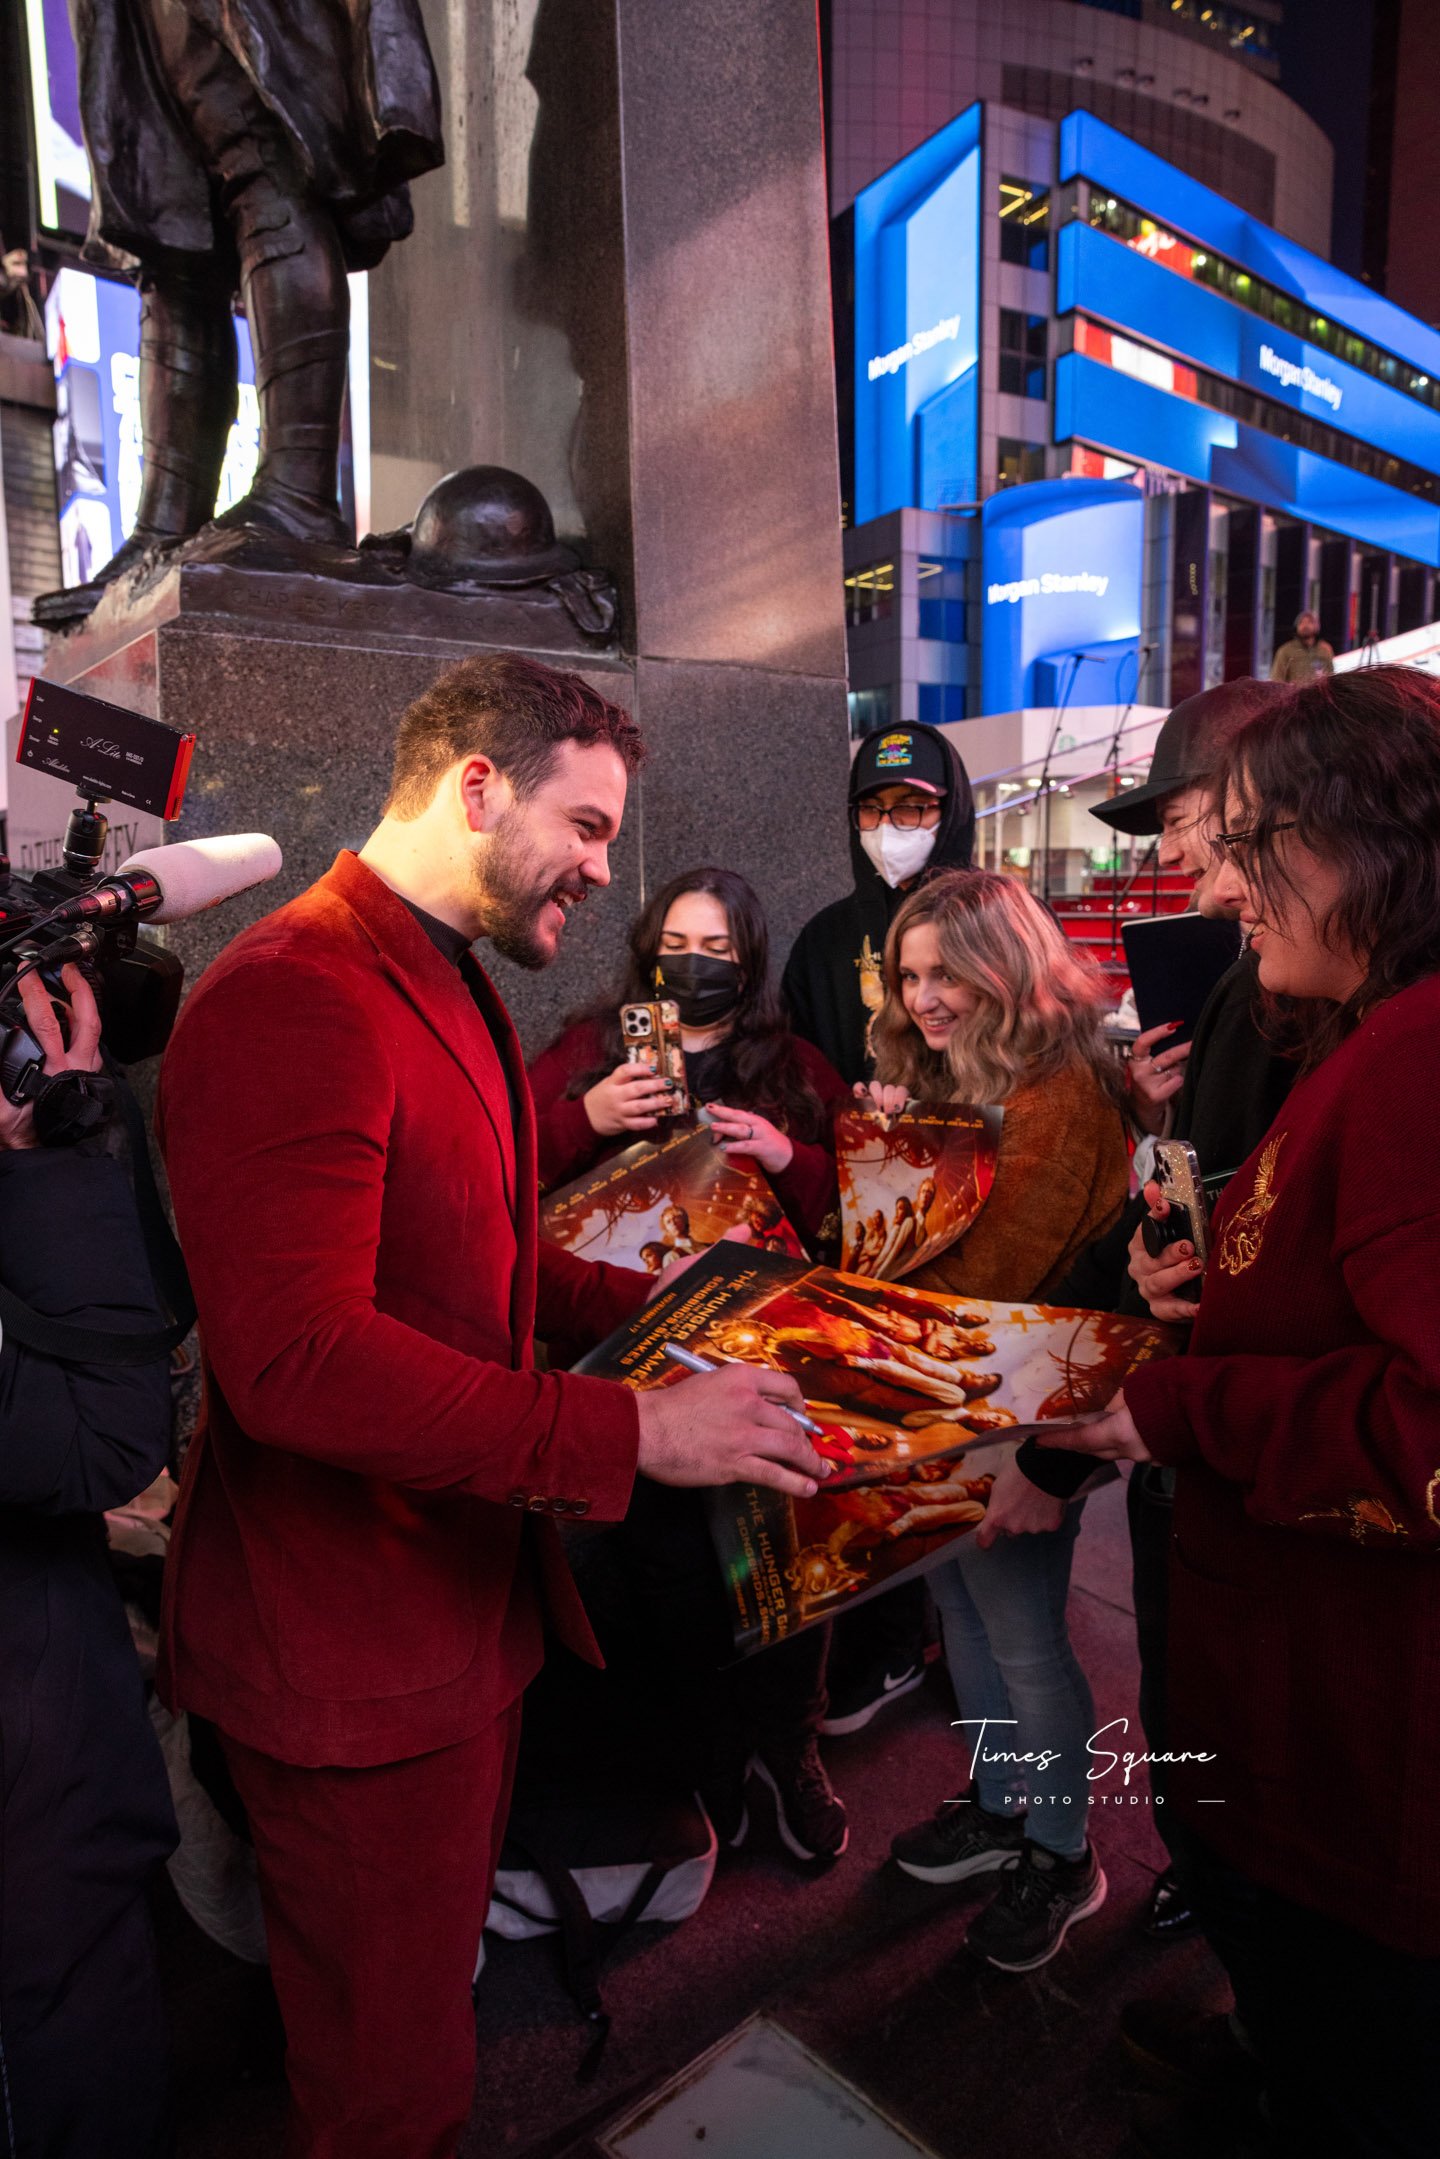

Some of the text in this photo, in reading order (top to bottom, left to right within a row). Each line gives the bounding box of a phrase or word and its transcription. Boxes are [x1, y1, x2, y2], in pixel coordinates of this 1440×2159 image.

[867, 313, 959, 381] Morgan Stanley
[1260, 344, 1343, 411] Morgan Stanley
[986, 573, 1108, 604] Morgan Stanley
[80, 736, 121, 760] A-Lite
[664, 1276, 724, 1325] SONGBIRDS
[726, 1269, 757, 1292] THE
[638, 1291, 676, 1324] NOVEMBER
[671, 1292, 731, 1341] HUNGER
[619, 1325, 665, 1366] SNAKES
[735, 1515, 765, 1601] SONGBIRDS
[745, 1488, 764, 1526] THE
[756, 1531, 786, 1610] HUNGER
